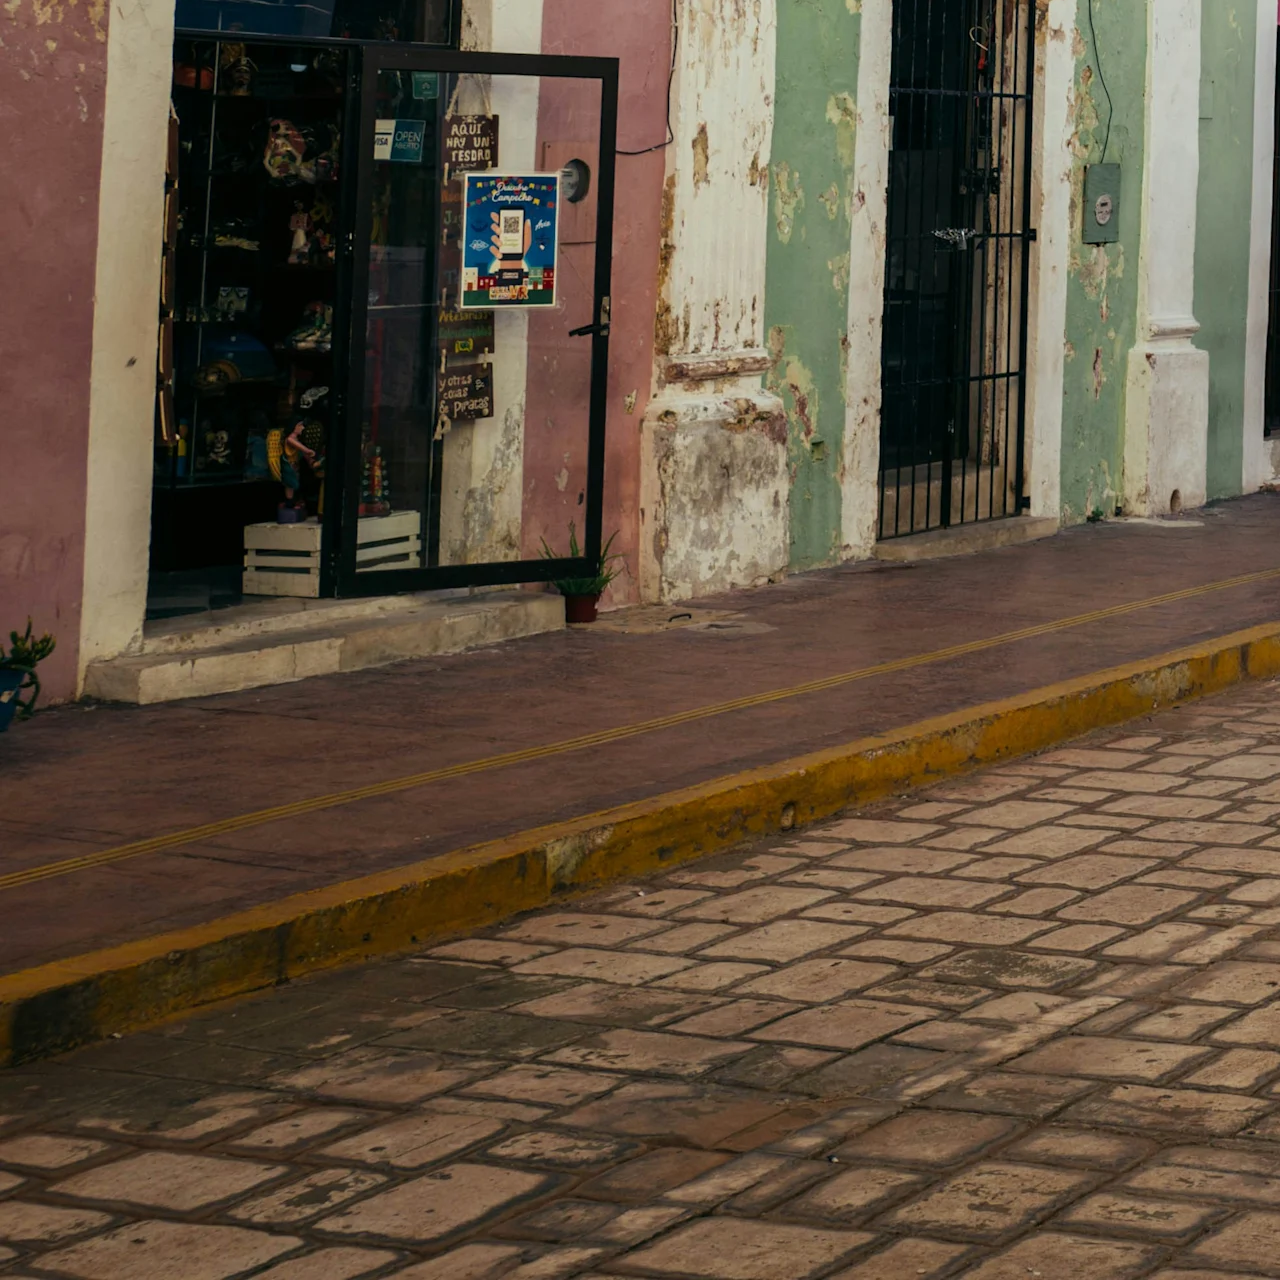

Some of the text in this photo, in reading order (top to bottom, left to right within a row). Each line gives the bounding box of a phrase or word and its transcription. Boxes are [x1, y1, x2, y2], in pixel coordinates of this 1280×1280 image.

[395, 131, 421, 143] OPEN
[446, 136, 490, 149] HAY UN
